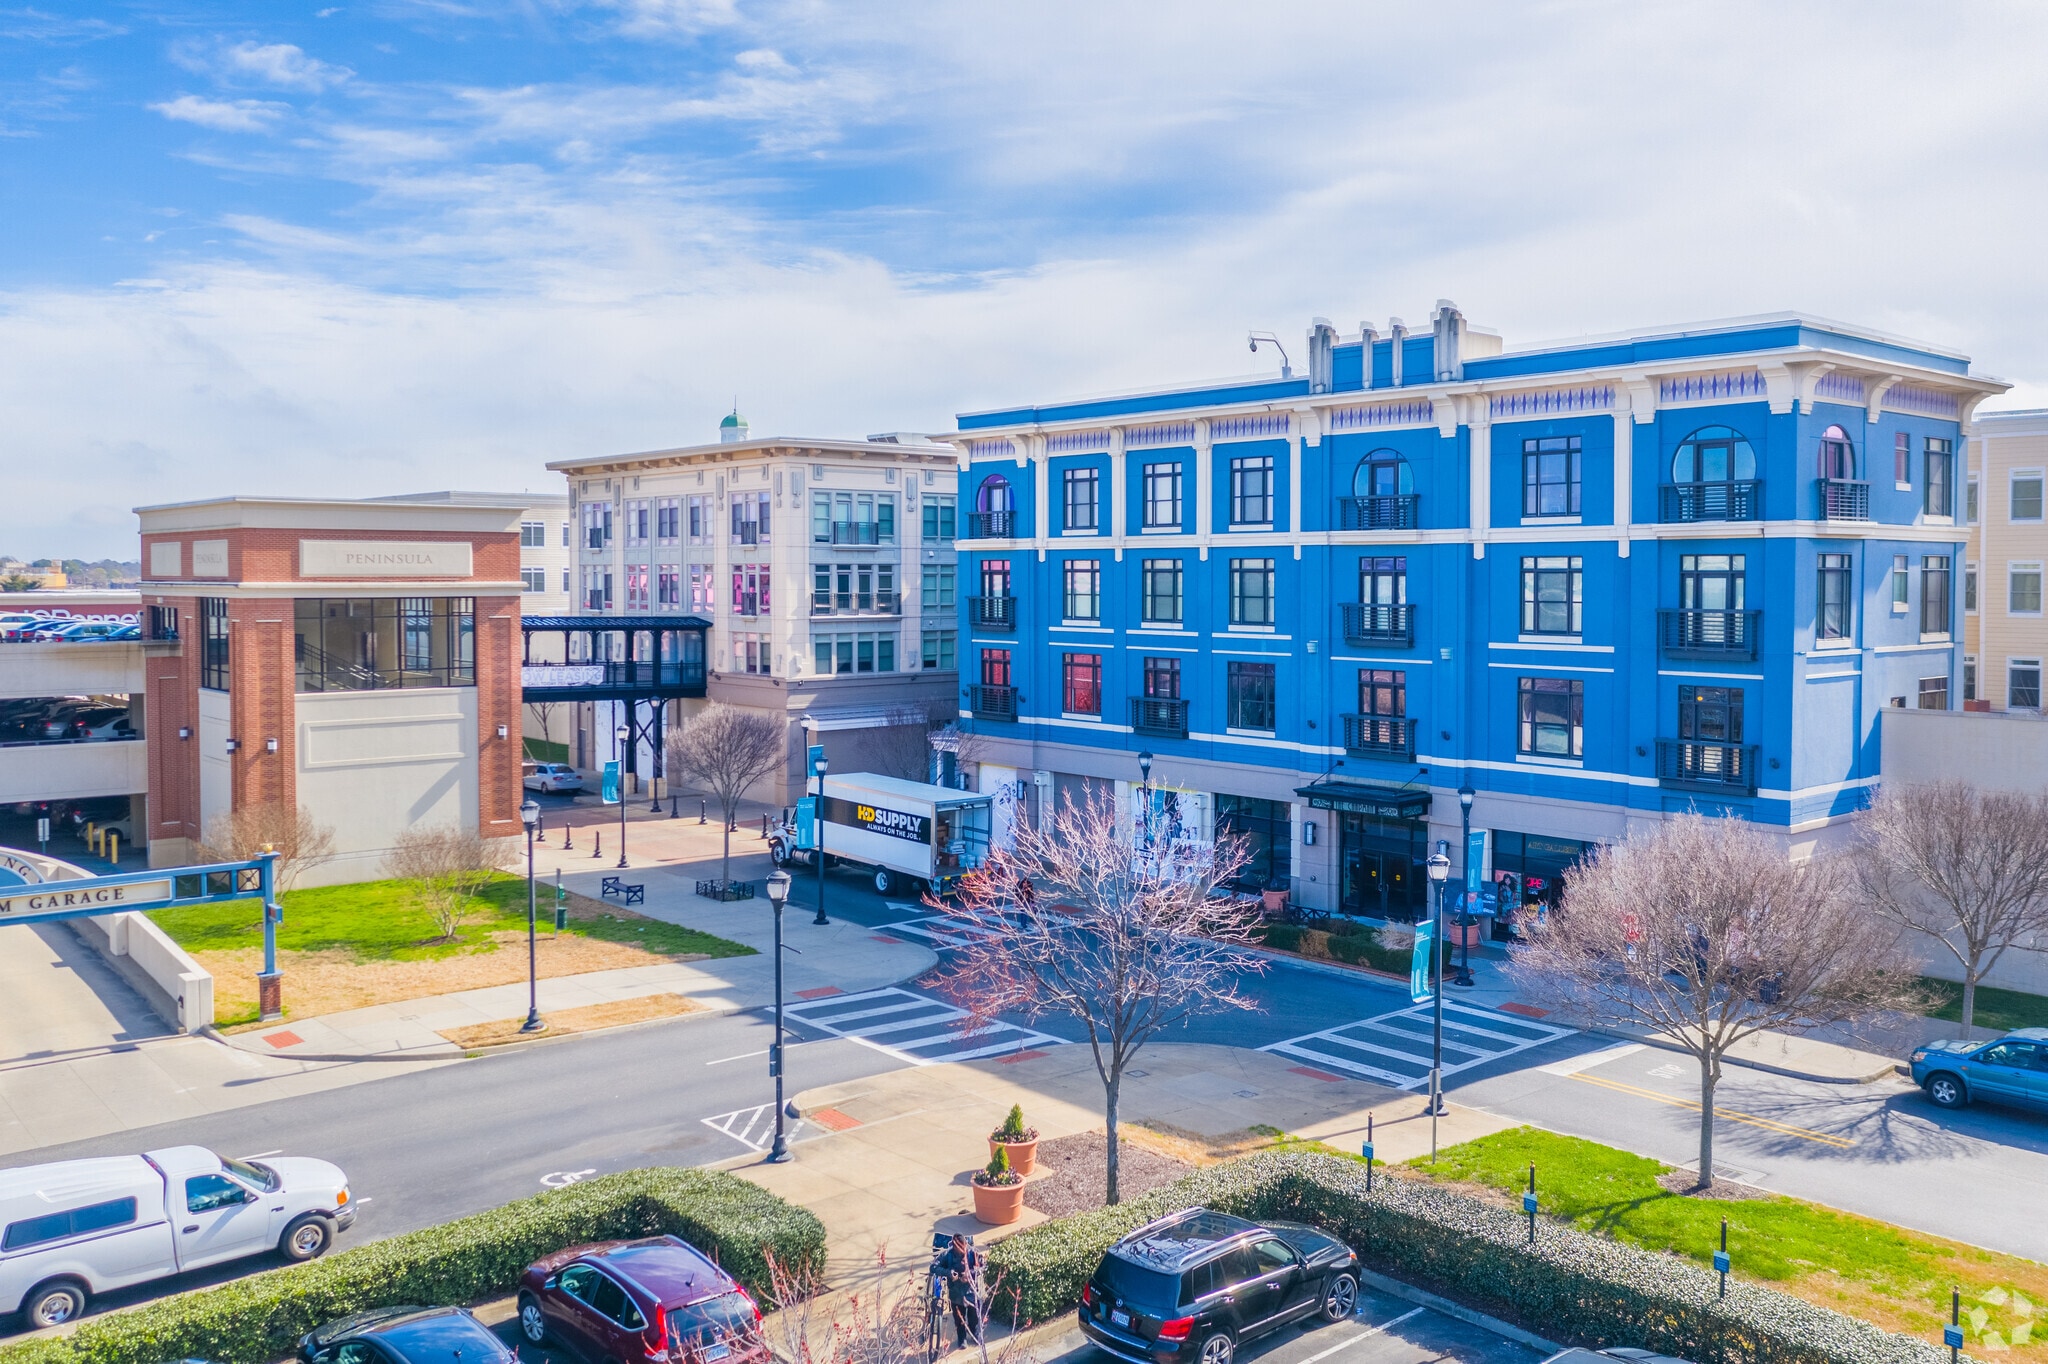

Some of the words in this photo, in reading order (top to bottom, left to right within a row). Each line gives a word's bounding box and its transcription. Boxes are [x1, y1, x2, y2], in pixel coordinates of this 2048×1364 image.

[346, 554, 433, 564] PENINSULA
[549, 672, 601, 682] LEASING
[867, 823, 887, 833] ALWAYS
[887, 827, 896, 835] ON
[896, 829, 906, 838] THE
[29, 888, 124, 910] GARAGE
